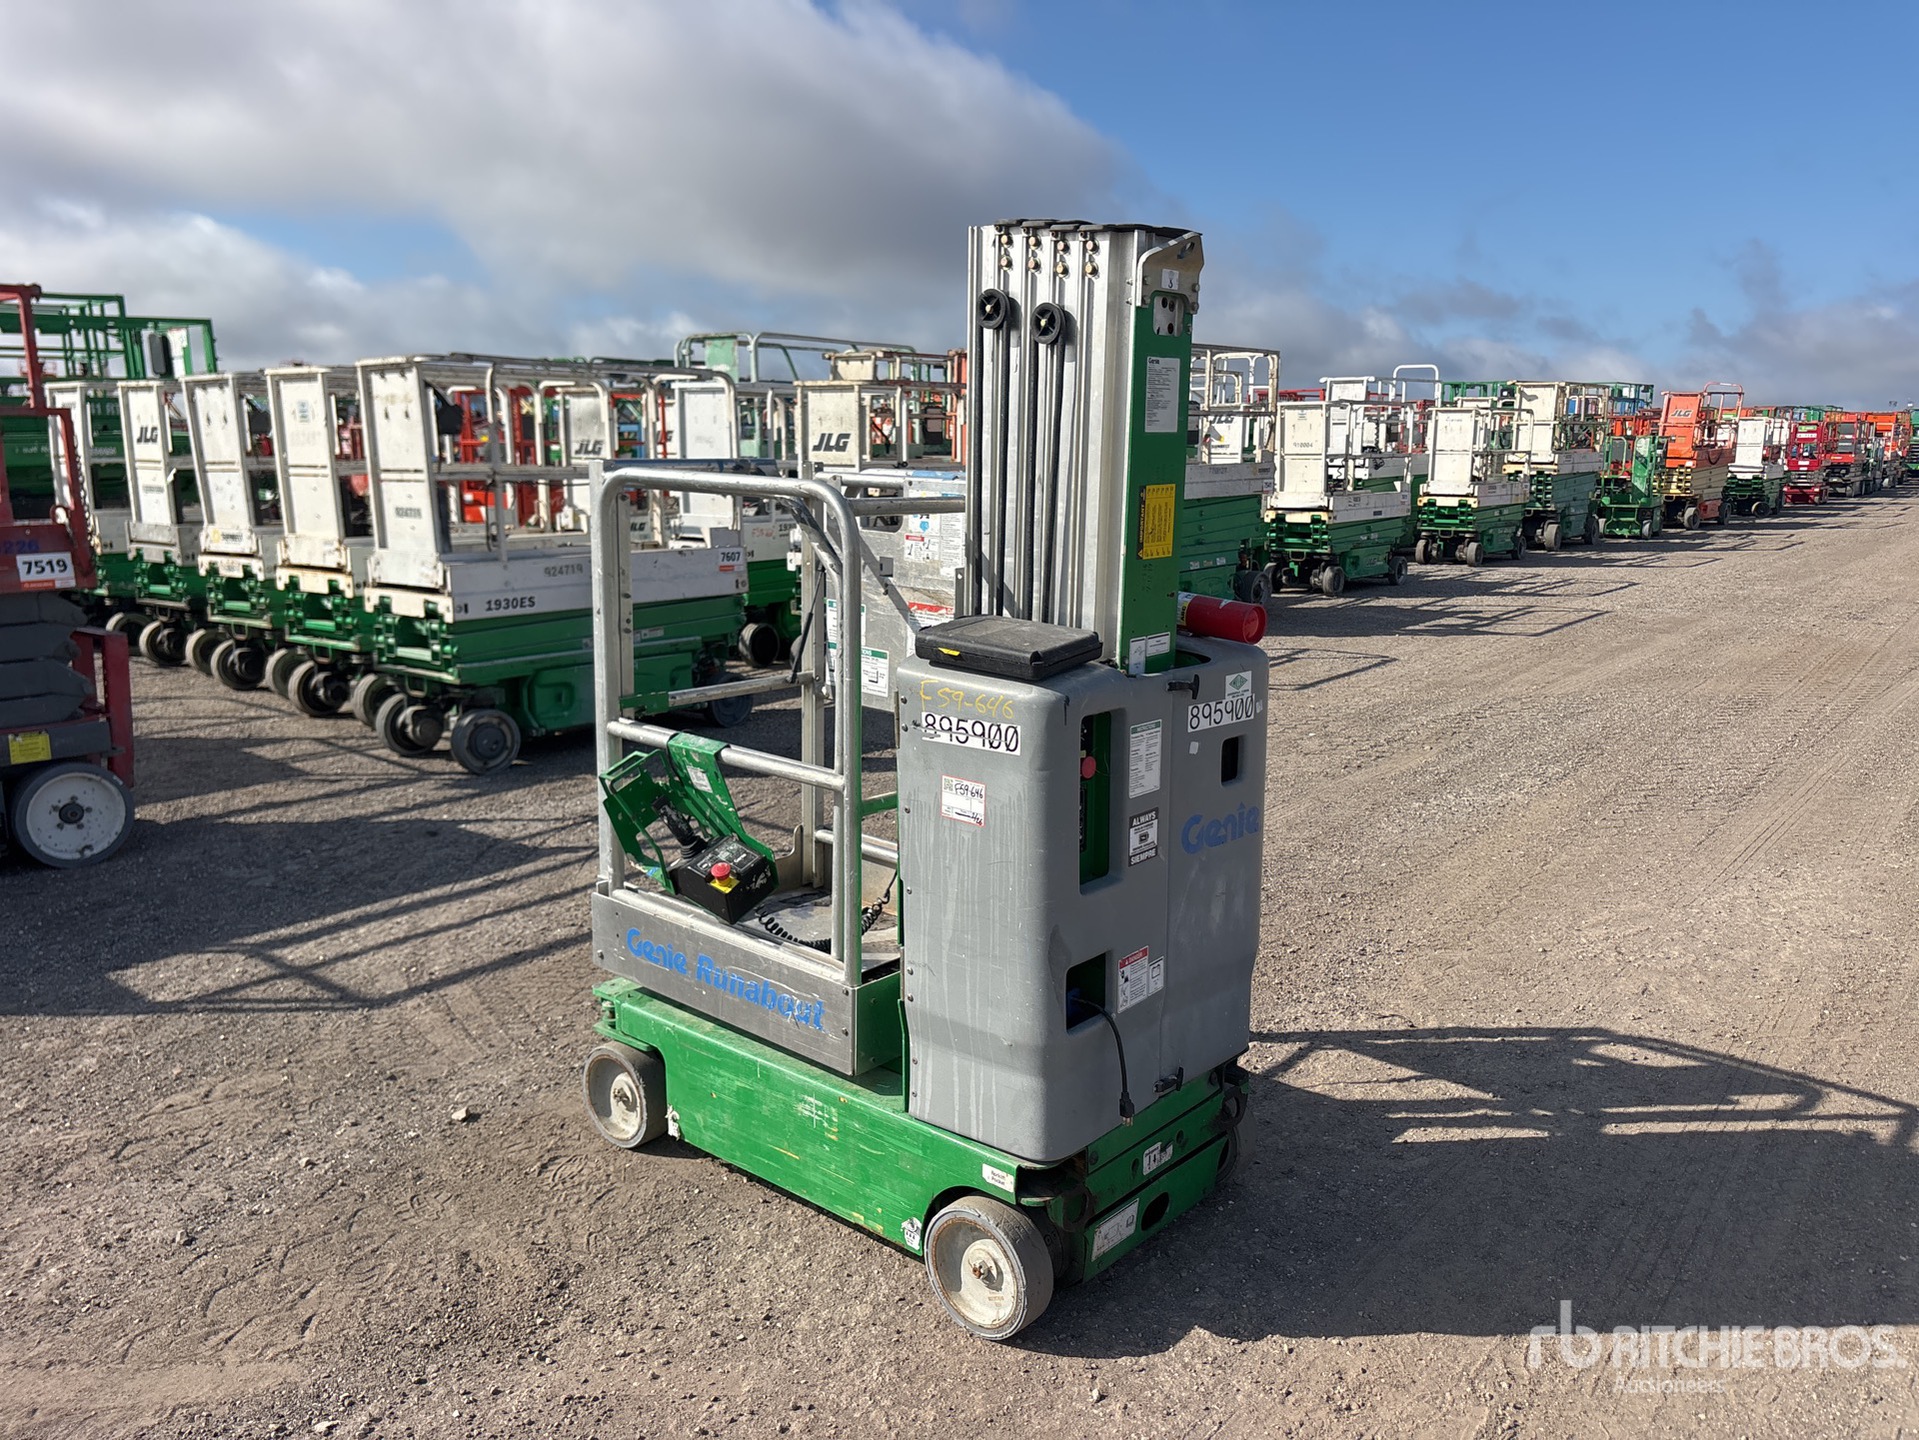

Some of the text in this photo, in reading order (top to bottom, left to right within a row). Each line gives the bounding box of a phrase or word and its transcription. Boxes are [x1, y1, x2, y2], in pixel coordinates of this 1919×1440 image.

[1671, 408, 1692, 419] JLG
[136, 426, 159, 443] JLG
[811, 432, 851, 453] JLG
[574, 439, 604, 456] JLG
[720, 551, 741, 563] 7607
[22, 558, 68, 576] 7519
[543, 563, 584, 578] 924719
[485, 596, 536, 612] 1930ES
[920, 678, 1015, 719] F59-646
[1189, 695, 1254, 730] 895900
[924, 713, 1019, 752] 895900
[1132, 811, 1156, 827] ALWAYS
[1181, 801, 1260, 855] Genie
[627, 927, 826, 1032] Genie Runabout
